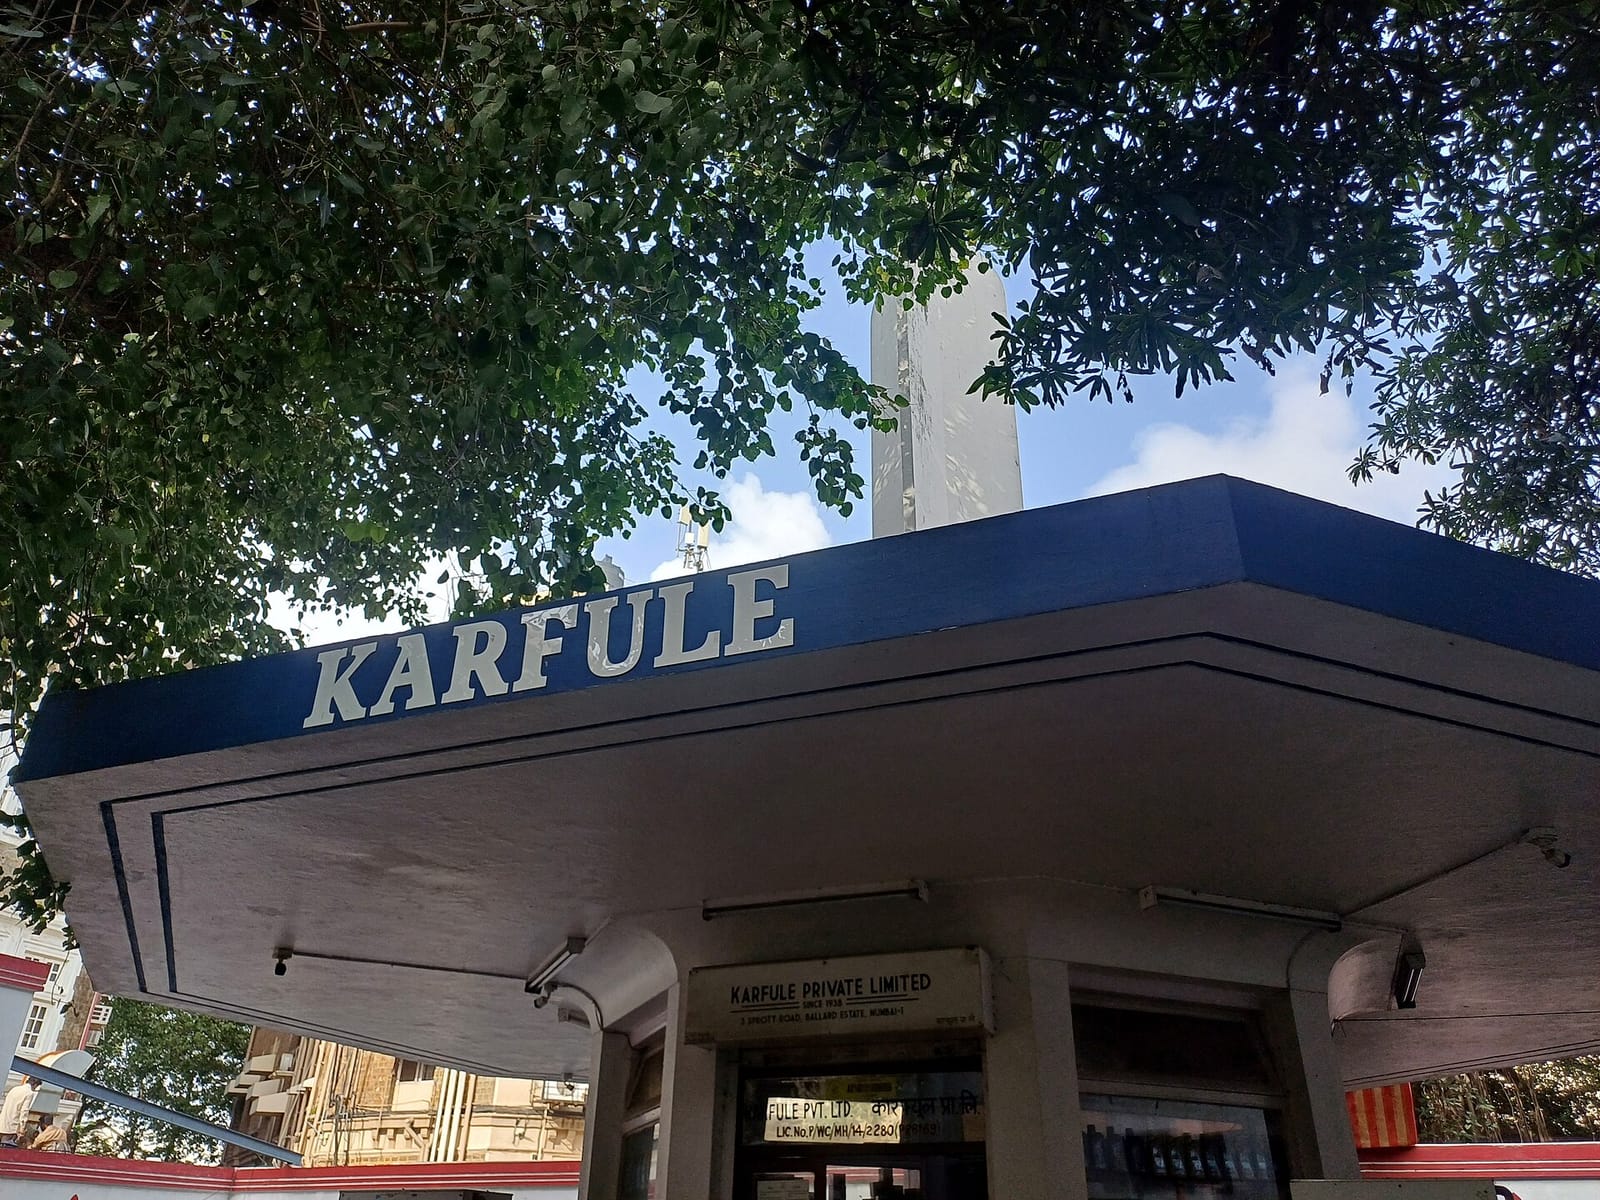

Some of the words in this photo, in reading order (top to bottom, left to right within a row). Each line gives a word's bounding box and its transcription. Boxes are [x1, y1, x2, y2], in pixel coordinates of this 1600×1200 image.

[302, 564, 796, 729] KARFULE
[731, 983, 796, 1005] KARFULE
[803, 978, 863, 998] PRIVATE
[871, 973, 932, 994] LIMITED
[805, 1011, 837, 1021] BALLARD
[804, 1102, 827, 1119] PVT.
[831, 1101, 853, 1118] LTD.
